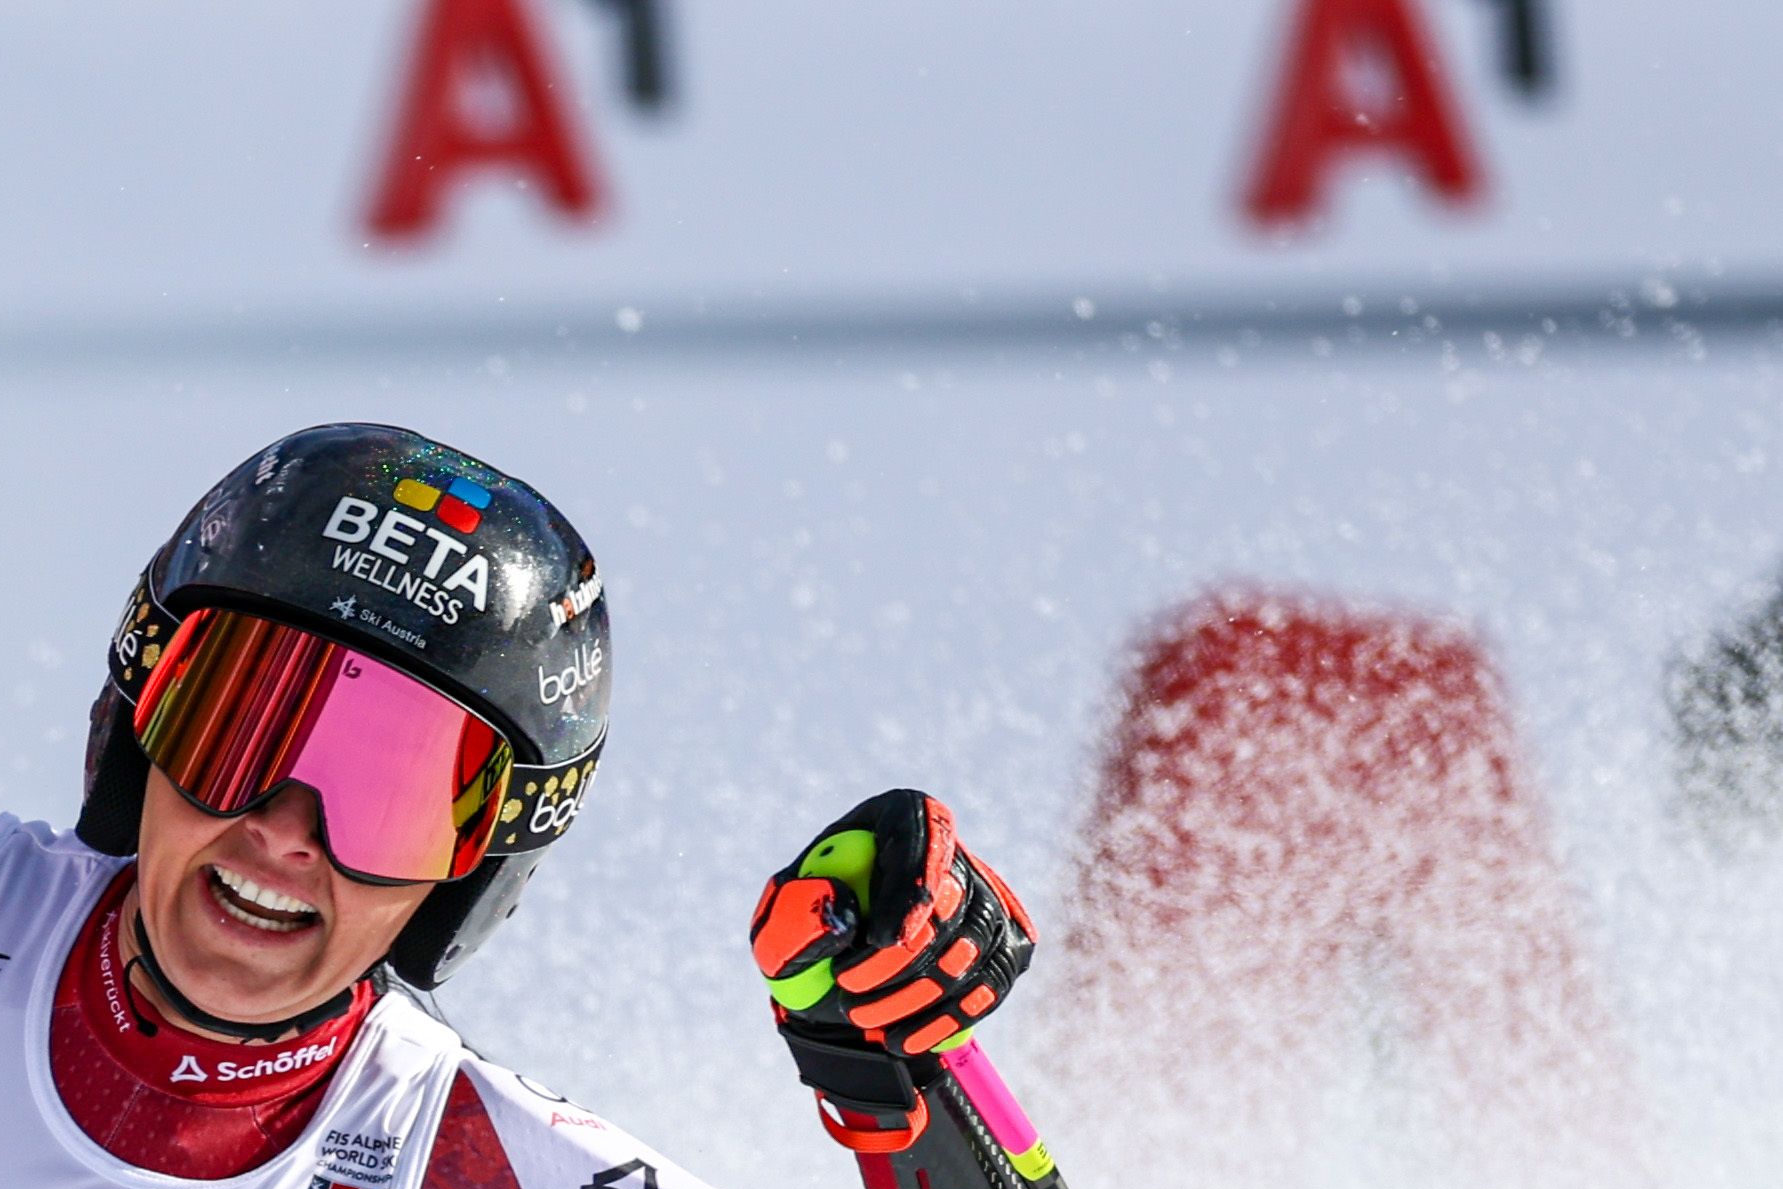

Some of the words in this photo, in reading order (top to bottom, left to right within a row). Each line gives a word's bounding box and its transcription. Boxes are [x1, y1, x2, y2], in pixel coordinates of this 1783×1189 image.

[322, 496, 489, 612] BETA
[332, 545, 464, 625] WELLNESS
[359, 609, 382, 626] Ski
[381, 620, 427, 650] Austria
[538, 638, 603, 705] bollé
[551, 1111, 607, 1131] Audi
[326, 1130, 350, 1146] FIS
[352, 1134, 402, 1153] ALPNE
[316, 1160, 393, 1184] CHAMPIONSHIP
[321, 1147, 378, 1169] WORLD
